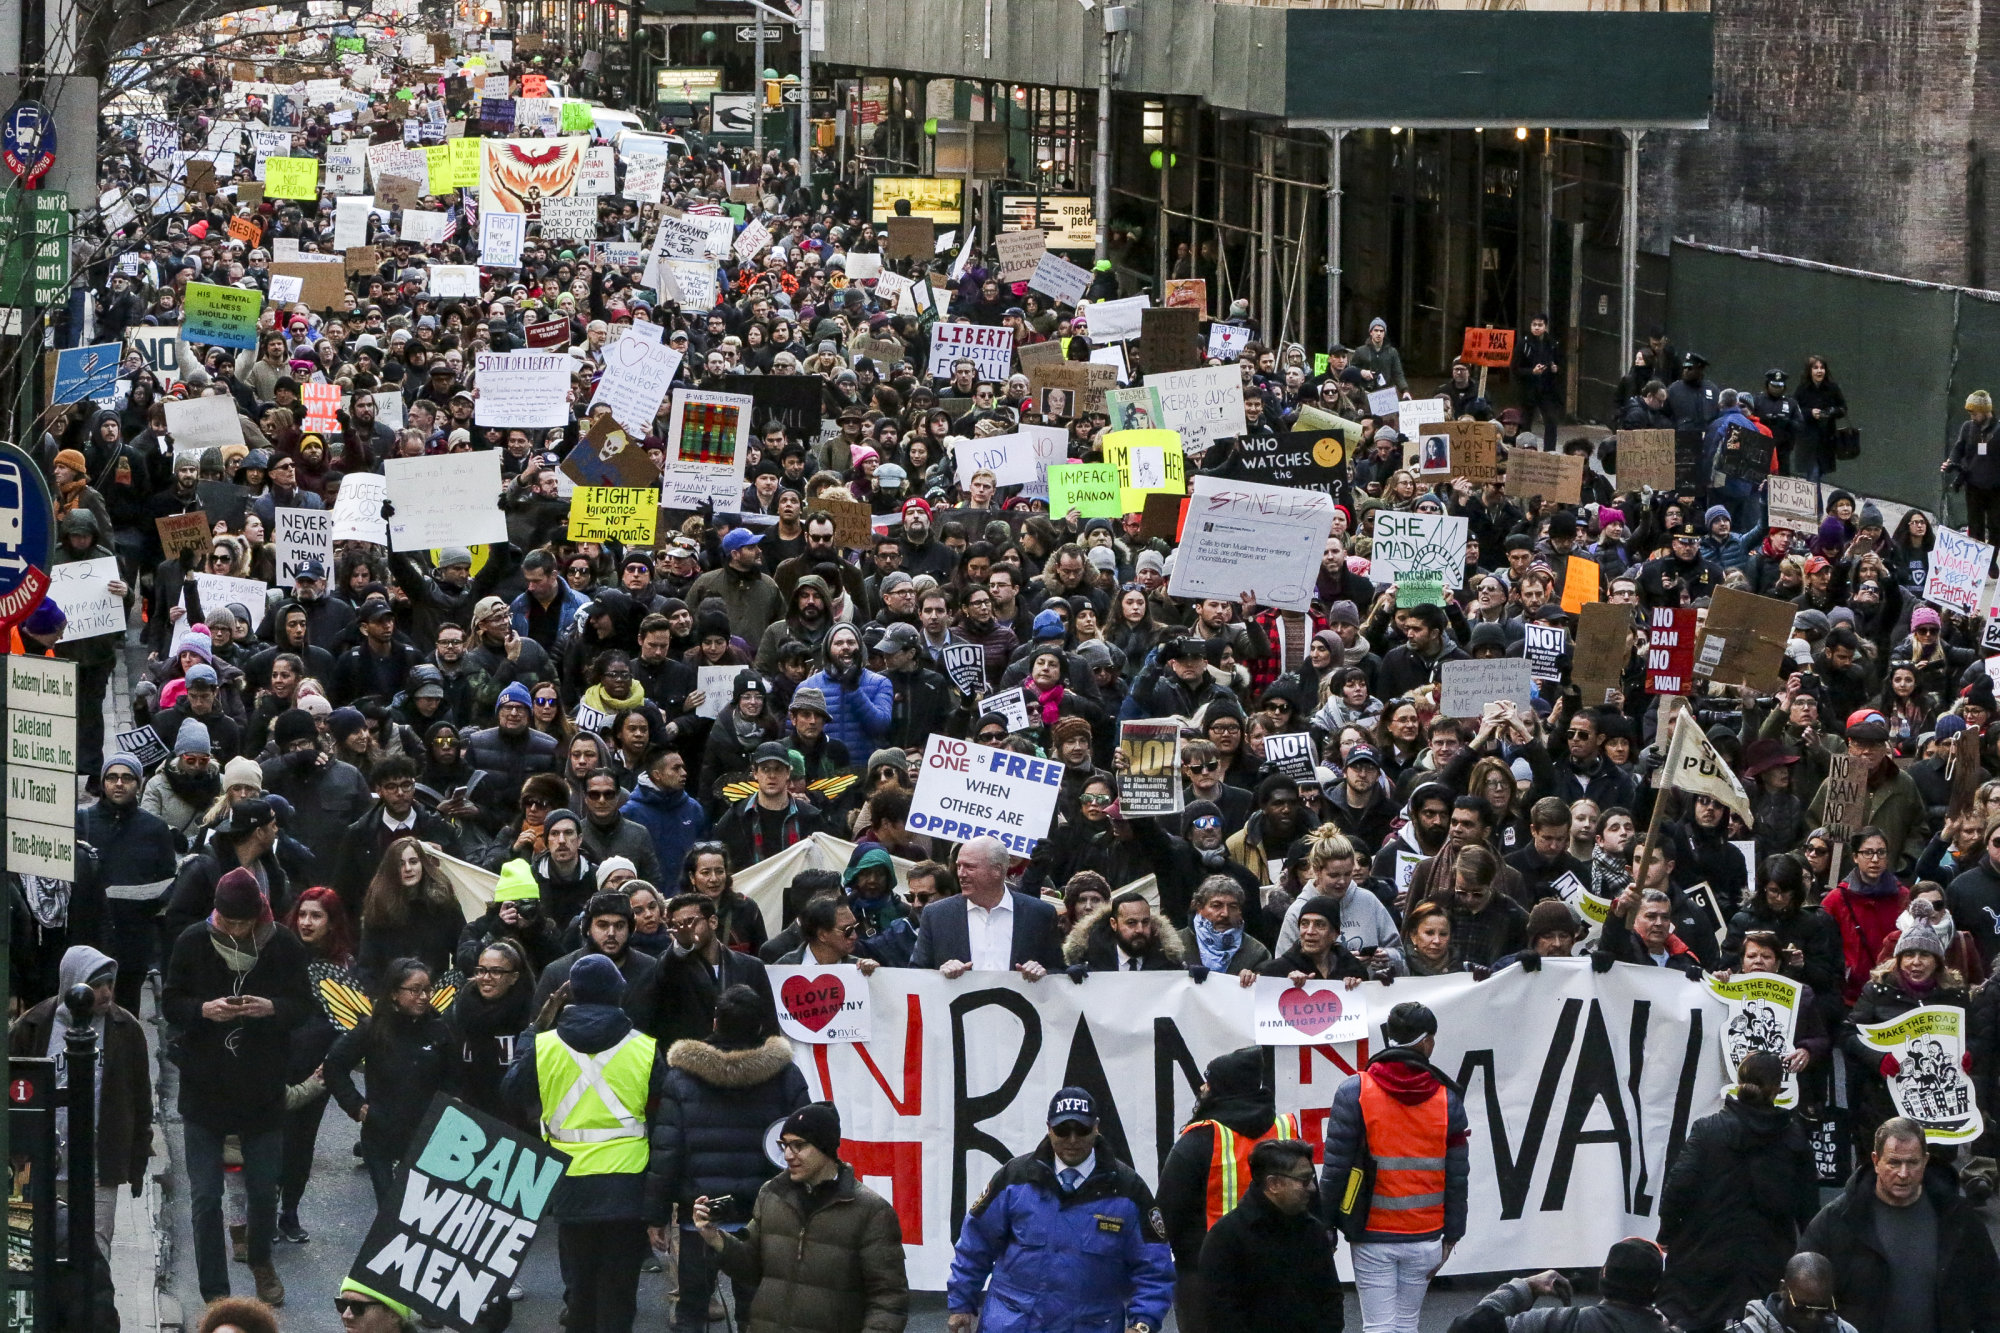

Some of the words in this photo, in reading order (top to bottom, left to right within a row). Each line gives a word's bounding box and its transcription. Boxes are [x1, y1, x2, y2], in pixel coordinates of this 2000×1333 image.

[267, 159, 314, 173] SYRIA-SLY
[328, 156, 351, 164] SYRIAN
[326, 165, 361, 175] REFUGEES
[283, 175, 298, 185] NOT
[273, 185, 307, 197] AFRAID
[541, 197, 596, 207] IMMIGRANT
[541, 209, 561, 217] JUST
[565, 209, 596, 217] ANOTHER
[542, 218, 572, 226] WORD
[576, 217, 596, 226] FOR
[491, 217, 516, 230] FIRST
[661, 219, 709, 240] IMMIGRANTS
[709, 221, 731, 234] BAN
[1071, 215, 1094, 229] pete
[230, 220, 261, 243] RESIST
[489, 232, 504, 240] THEY
[541, 228, 597, 239] AMERICAN
[664, 230, 676, 239] WE
[677, 234, 699, 243] GET
[664, 240, 677, 249] THE
[36, 264, 61, 281] QM11
[881, 273, 894, 285] NO
[196, 290, 211, 298] HIS
[221, 293, 252, 304] MENTAL
[877, 288, 890, 297] NO
[209, 301, 242, 311] ILLNESS
[196, 309, 228, 319] SHOULD
[231, 313, 248, 322] NOT
[189, 327, 216, 337] PUBLIC
[217, 331, 246, 341] POLICY
[221, 323, 238, 331] OUR
[529, 327, 545, 336] JEWS
[545, 321, 567, 333] REJECT
[538, 329, 560, 338] TRUMP
[937, 326, 1014, 350] LIBERTY
[134, 337, 178, 372] NO
[649, 346, 677, 369] LOVE
[948, 345, 1010, 363] JUSTICE
[522, 356, 563, 371] LIBERTY
[639, 360, 665, 383] YOUR
[977, 363, 1005, 381] ALL
[608, 364, 660, 394] NEIGHBOR
[1090, 370, 1115, 380] WERE
[1164, 374, 1198, 390] LEAVE
[1204, 373, 1218, 386] MY
[304, 383, 340, 399] NOT
[1161, 392, 1200, 412] KEBAB
[1204, 387, 1236, 405] GUYS
[1184, 406, 1224, 423] ALONE!
[1415, 402, 1438, 411] WILL
[303, 418, 342, 432] PREZ
[1457, 424, 1482, 436] WE
[1241, 438, 1278, 451] WHO
[1242, 452, 1312, 469] WATCHES
[1464, 452, 1483, 462] BE
[1060, 468, 1115, 485] IMPEACH
[1164, 454, 1184, 482] HER
[1273, 470, 1293, 479] the
[1453, 466, 1496, 477] DIVIDED
[694, 474, 713, 482] ARE
[595, 488, 646, 505] FIGHT
[711, 485, 738, 495] RIGHTS
[1772, 480, 1790, 490] NO
[1794, 482, 1813, 496] BAN
[1067, 491, 1115, 504] BANNON
[1208, 491, 1328, 521] SPINELESS
[1772, 493, 1789, 504] NO
[1791, 495, 1814, 510] WALL
[281, 513, 328, 531] NEVER
[605, 515, 631, 526] NOT
[1378, 514, 1426, 537] SHE
[283, 530, 327, 547] AGAIN
[575, 523, 650, 541] Immigrants
[291, 549, 325, 564] MEANS
[1254, 553, 1267, 561] and
[1374, 540, 1415, 560] MAD
[1938, 532, 1986, 565] NASTY
[78, 562, 98, 579] 2
[1936, 550, 1980, 579] WOMEN
[1393, 570, 1443, 581] IMMIGRANTS
[1945, 568, 1969, 586] KEEP
[230, 581, 264, 596] BUSINESS
[1929, 578, 1978, 611] FIGHTING
[1652, 608, 1673, 628] NO
[1528, 626, 1561, 651] NO!
[1651, 630, 1679, 647] BAN
[946, 646, 982, 670] NO!
[1649, 649, 1670, 670] NO
[1443, 663, 1480, 673] Whatever
[1483, 664, 1496, 672] you
[1497, 662, 1507, 670] did
[12, 668, 41, 696] Academy
[42, 672, 62, 698] Lines,
[62, 674, 73, 697] Inc
[1453, 699, 1471, 711] ME
[13, 713, 52, 738] Lakeland
[118, 725, 155, 751] NO!
[13, 739, 29, 758] Bus
[58, 745, 74, 766] Inc.
[937, 739, 967, 757] NO
[1266, 734, 1307, 761] NO!
[1121, 739, 1176, 776] NO!
[929, 754, 971, 773] ONE
[977, 754, 985, 764] IS
[989, 751, 1063, 787] FREE
[1832, 755, 1849, 778] NO
[12, 777, 19, 798] N
[20, 779, 26, 798] J
[28, 780, 57, 805] Transit
[966, 778, 1011, 799] WHEN
[1829, 779, 1858, 802] BAN
[939, 796, 992, 819] OTHERS
[996, 809, 1025, 826] ARE
[1825, 803, 1844, 824] NO
[1829, 825, 1851, 843] WALL
[11, 831, 53, 863] Trans-Bridge
[53, 840, 72, 862] Lines
[796, 986, 840, 1007] LOVE
[1717, 983, 1744, 992] MAKE
[1746, 981, 1764, 991] THE
[1765, 981, 1794, 997] ROAD
[1751, 989, 1770, 998] NEW
[1770, 992, 1792, 1005] YORK
[1282, 1006, 1287, 1016] I
[1294, 1002, 1337, 1015] LOVE
[1260, 1014, 1361, 1028] #IMMIGRANTNY
[1877, 1026, 1906, 1041] MAKE
[1907, 1018, 1926, 1030] THE
[1926, 1012, 1958, 1024] ROAD
[1913, 1025, 1933, 1035] NEW
[1934, 1024, 1957, 1033] YORK
[837, 1026, 861, 1039] nyic
[1055, 1097, 1089, 1113] NYPD
[415, 1105, 564, 1221] BAN
[398, 1168, 538, 1279] WHITE
[365, 1231, 497, 1326] MEN
